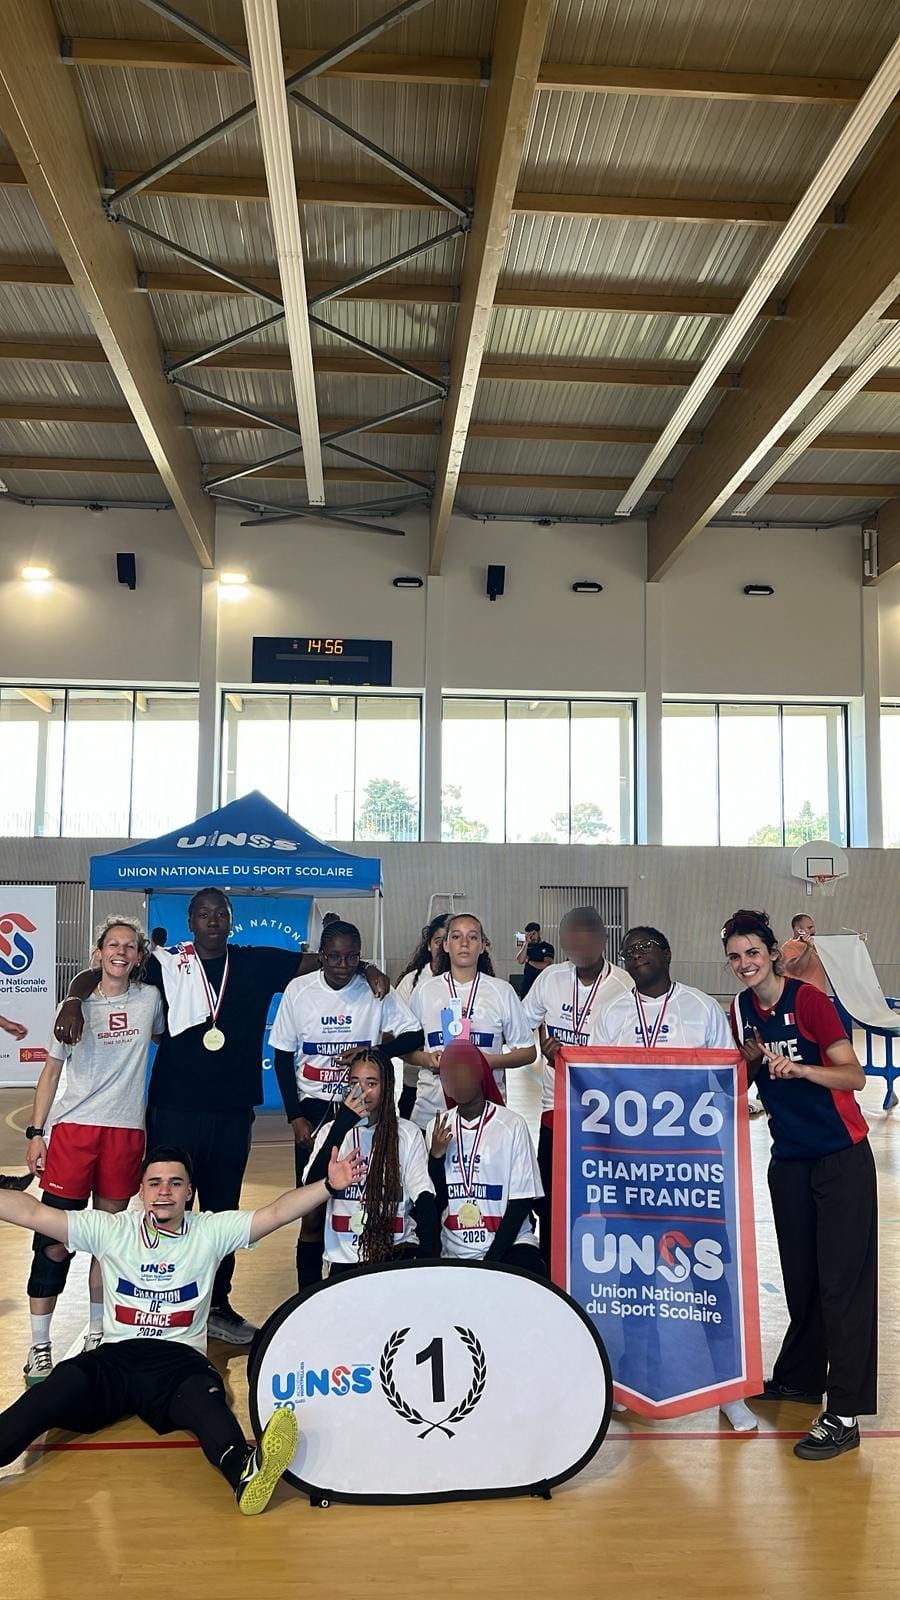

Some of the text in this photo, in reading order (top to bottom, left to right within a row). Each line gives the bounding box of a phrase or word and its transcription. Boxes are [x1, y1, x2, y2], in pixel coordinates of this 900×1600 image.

[118, 865, 353, 877] UNION NATIONALE DU SPORT SCOLAIRE
[15, 985, 48, 993] Scolaire
[321, 1013, 353, 1026] UNSS
[581, 1089, 724, 1137] 2026
[582, 1159, 725, 1183] CHAMPIONS
[586, 1184, 721, 1209] DE FRANCE
[462, 1230, 486, 1243] 2026
[581, 1230, 724, 1283] UNSS
[140, 1263, 176, 1275] UNSS
[133, 1287, 181, 1303] CHAMPION
[590, 1283, 717, 1306] Union Nationale
[149, 1300, 163, 1313] DE
[586, 1299, 722, 1324] du Sport Scolaire
[134, 1311, 172, 1327] FRANCE
[415, 1337, 446, 1404] 1
